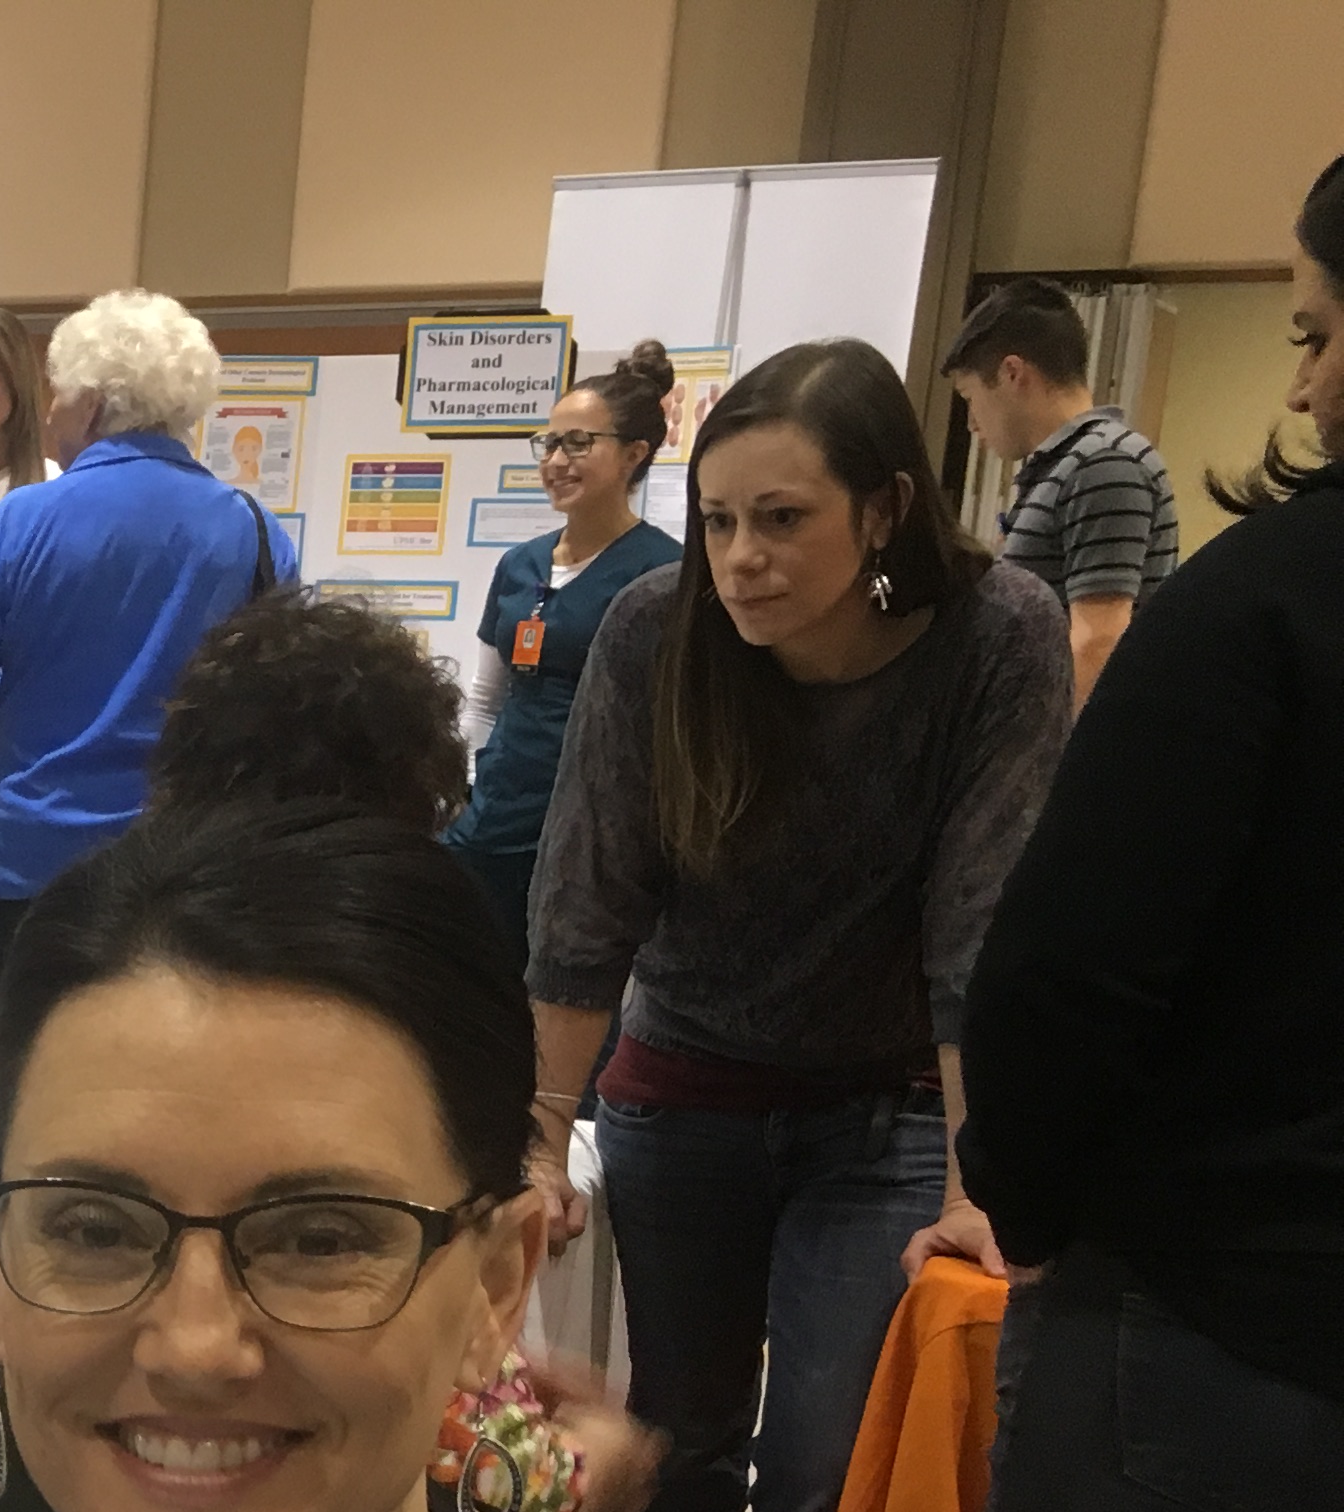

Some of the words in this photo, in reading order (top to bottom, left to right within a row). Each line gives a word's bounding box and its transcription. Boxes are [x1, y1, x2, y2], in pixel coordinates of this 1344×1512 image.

[427, 331, 464, 347] Skin
[470, 330, 552, 346] Disorders
[471, 354, 502, 368] and
[416, 376, 556, 395] Pharmacological
[428, 400, 538, 417] Management
